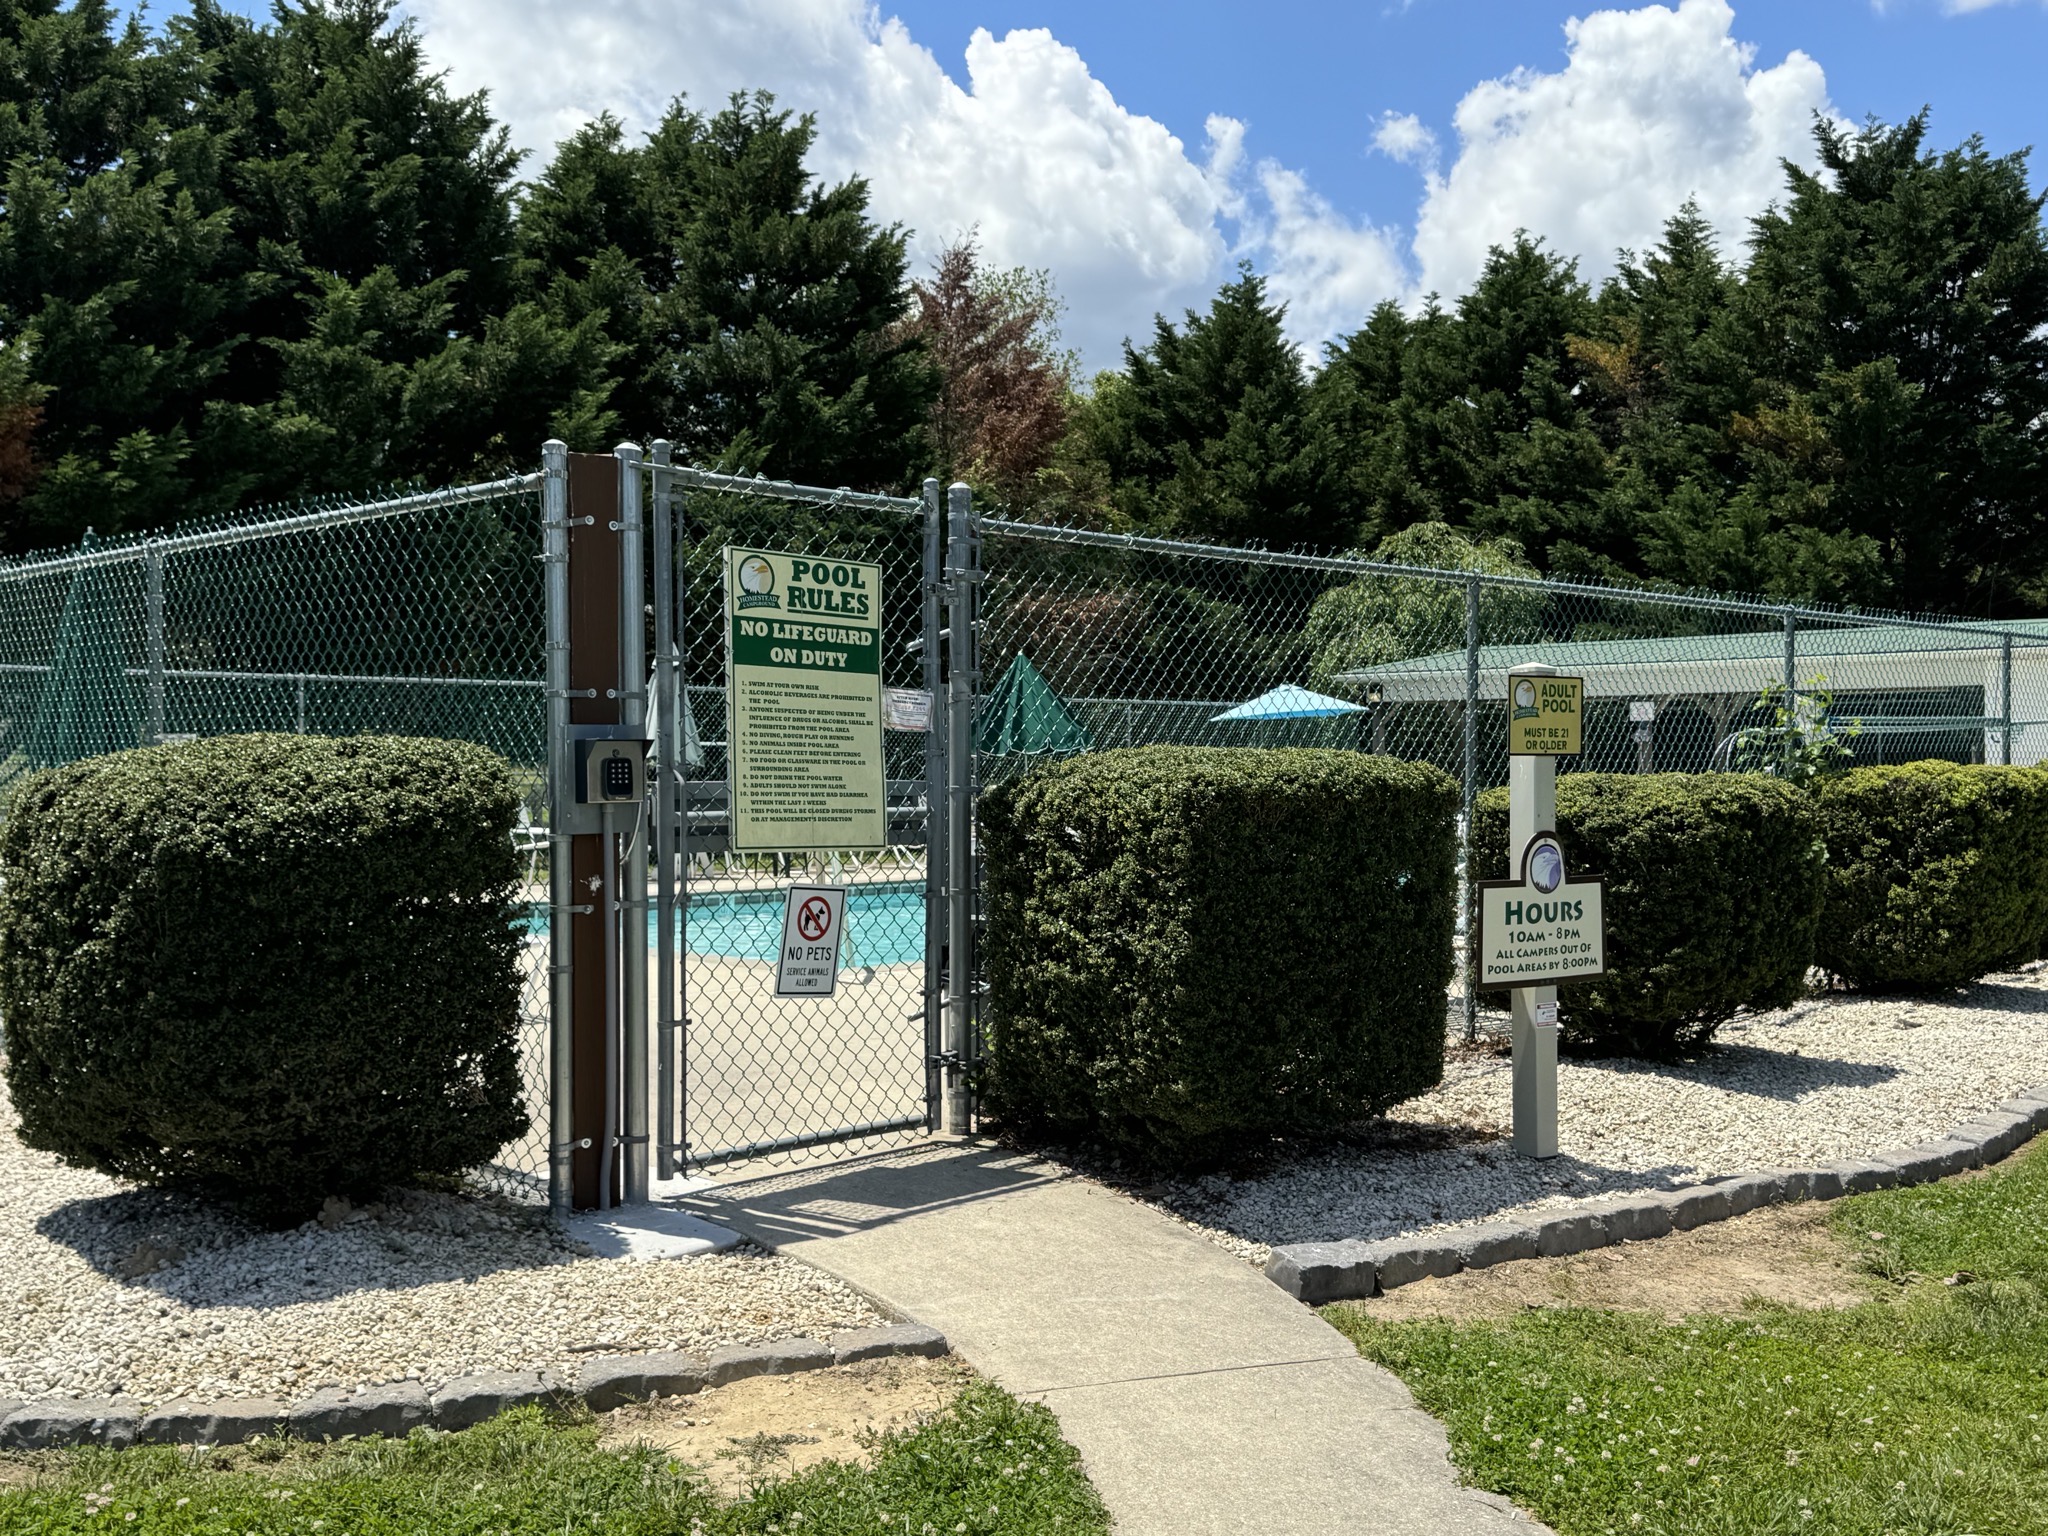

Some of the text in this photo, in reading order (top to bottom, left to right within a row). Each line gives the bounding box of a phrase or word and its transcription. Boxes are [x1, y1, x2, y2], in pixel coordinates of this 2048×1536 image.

[792, 560, 866, 589] POOL
[740, 595, 777, 603] HOMESTEAD
[787, 586, 869, 615] RULES
[740, 620, 872, 646] NO LIFEGUARD
[770, 647, 848, 667] ON DUTY
[1541, 684, 1577, 698] ADULT
[1543, 699, 1575, 713] POOL
[1524, 728, 1569, 737] MUST BE 21
[1526, 741, 1567, 750] OR OLDER
[1505, 900, 1583, 925] HOURS
[1509, 931, 1546, 943] 10AM
[1556, 927, 1580, 939] 8PM
[788, 946, 832, 960] NO PETS
[1496, 943, 1591, 959] ALL CAMPERS OUT OF
[787, 967, 829, 976] SERVICE ANIMALS
[1488, 957, 1598, 975] POOL AREAS BY 8:00PM
[796, 978, 818, 986] ALLOWED
